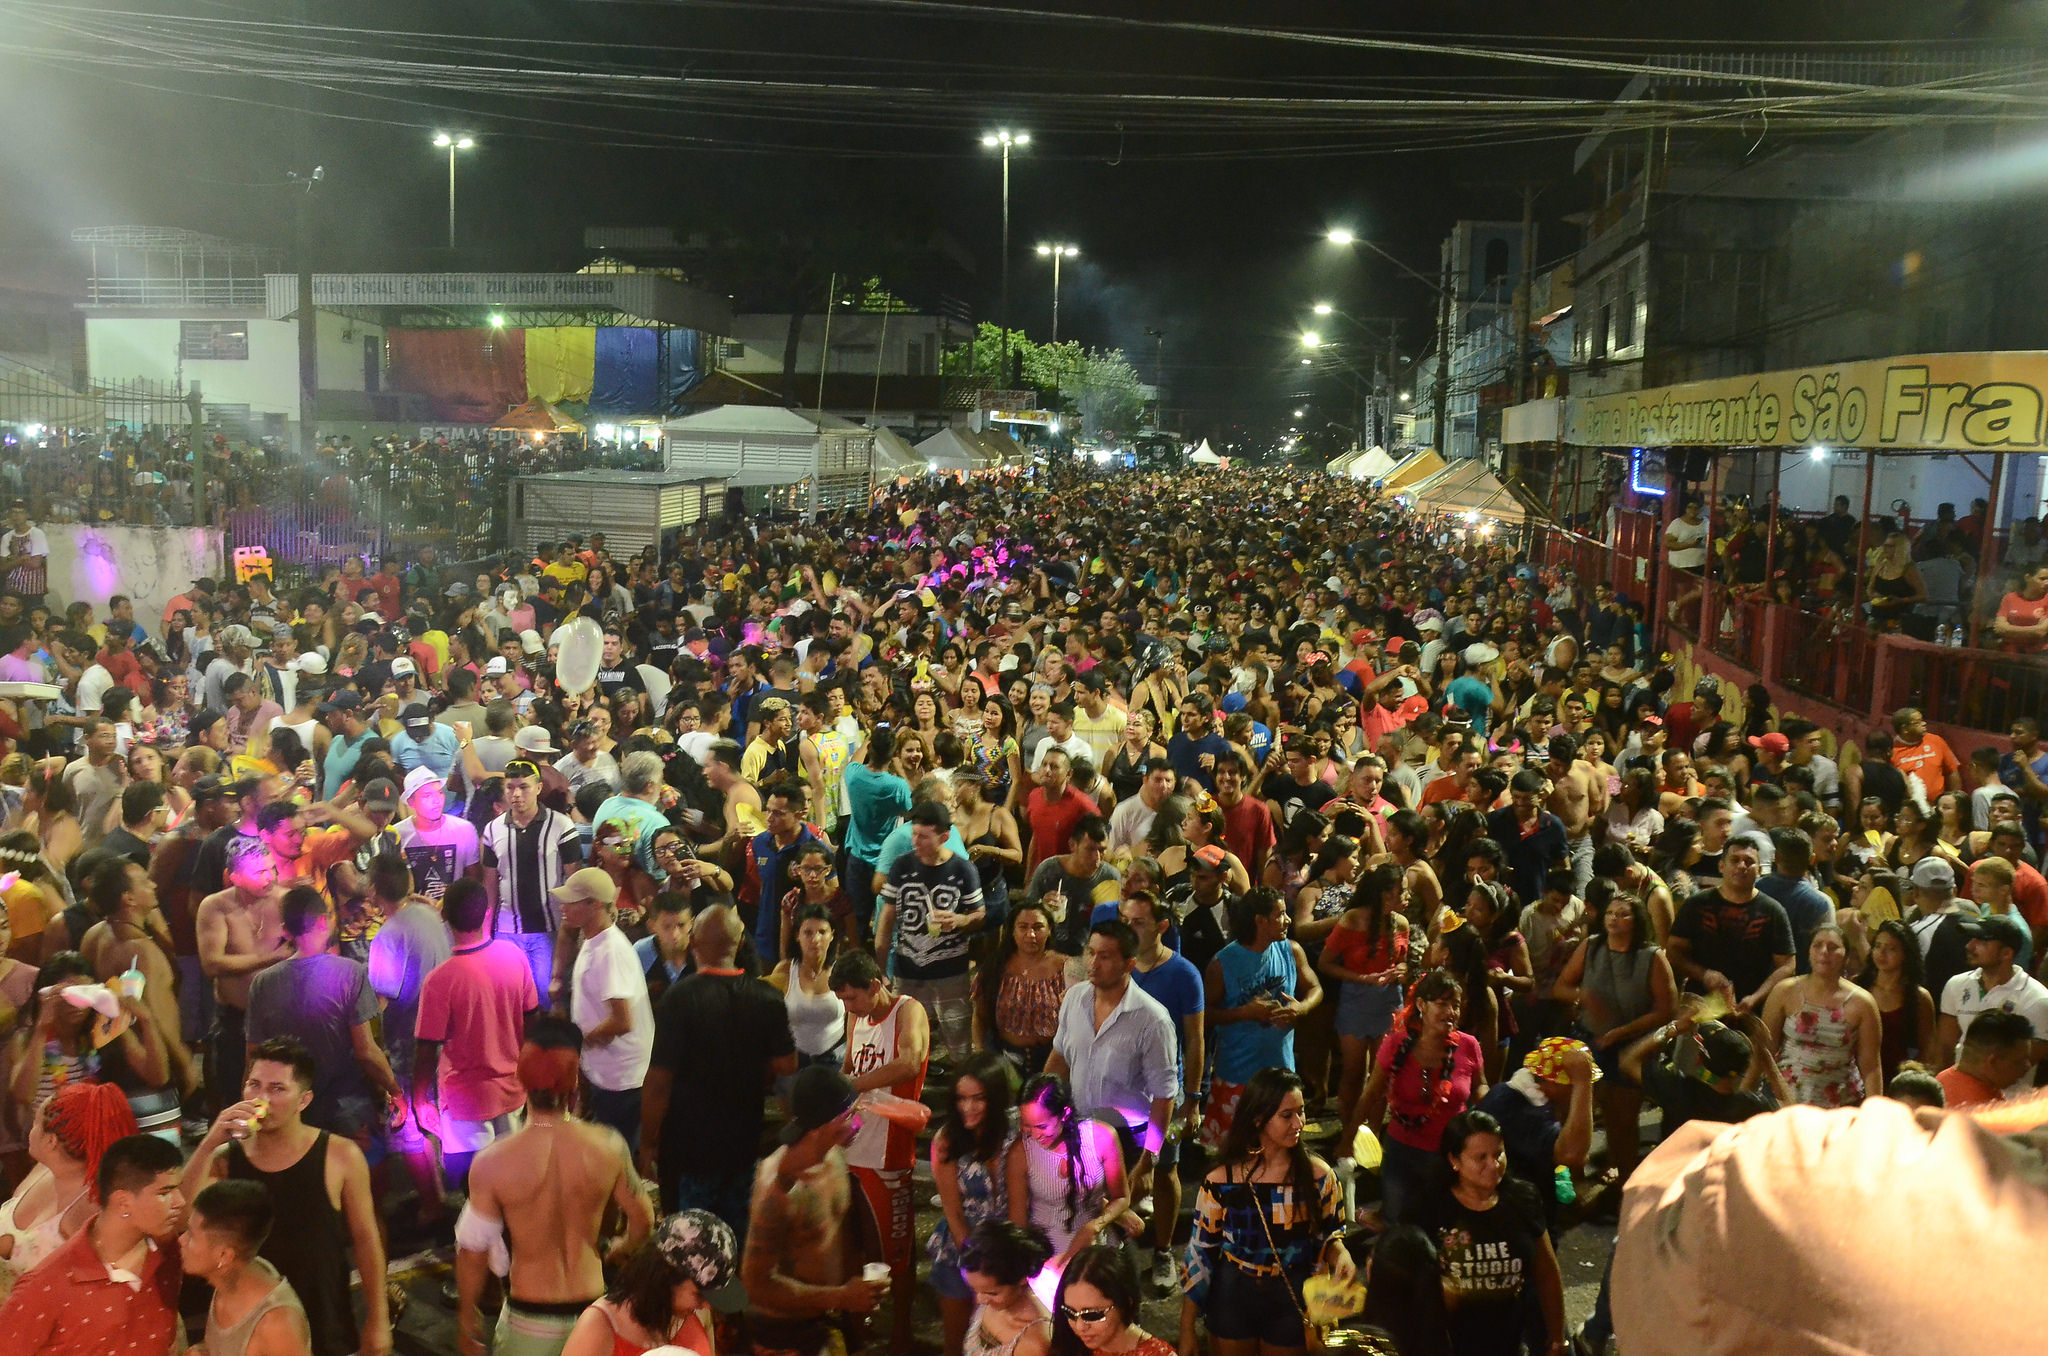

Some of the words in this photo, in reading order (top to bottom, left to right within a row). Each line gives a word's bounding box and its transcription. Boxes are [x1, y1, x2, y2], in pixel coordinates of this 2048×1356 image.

[352, 281, 396, 295] SOCIAL
[403, 281, 410, 295] E
[554, 279, 613, 295] PINHEIRO
[1612, 408, 1621, 443] e
[1625, 382, 1780, 444] Restaurante
[1788, 372, 1867, 444] São
[1879, 364, 2048, 447] Fra
[1464, 1241, 1510, 1261] LINE
[1449, 1257, 1522, 1277] STUDIO
